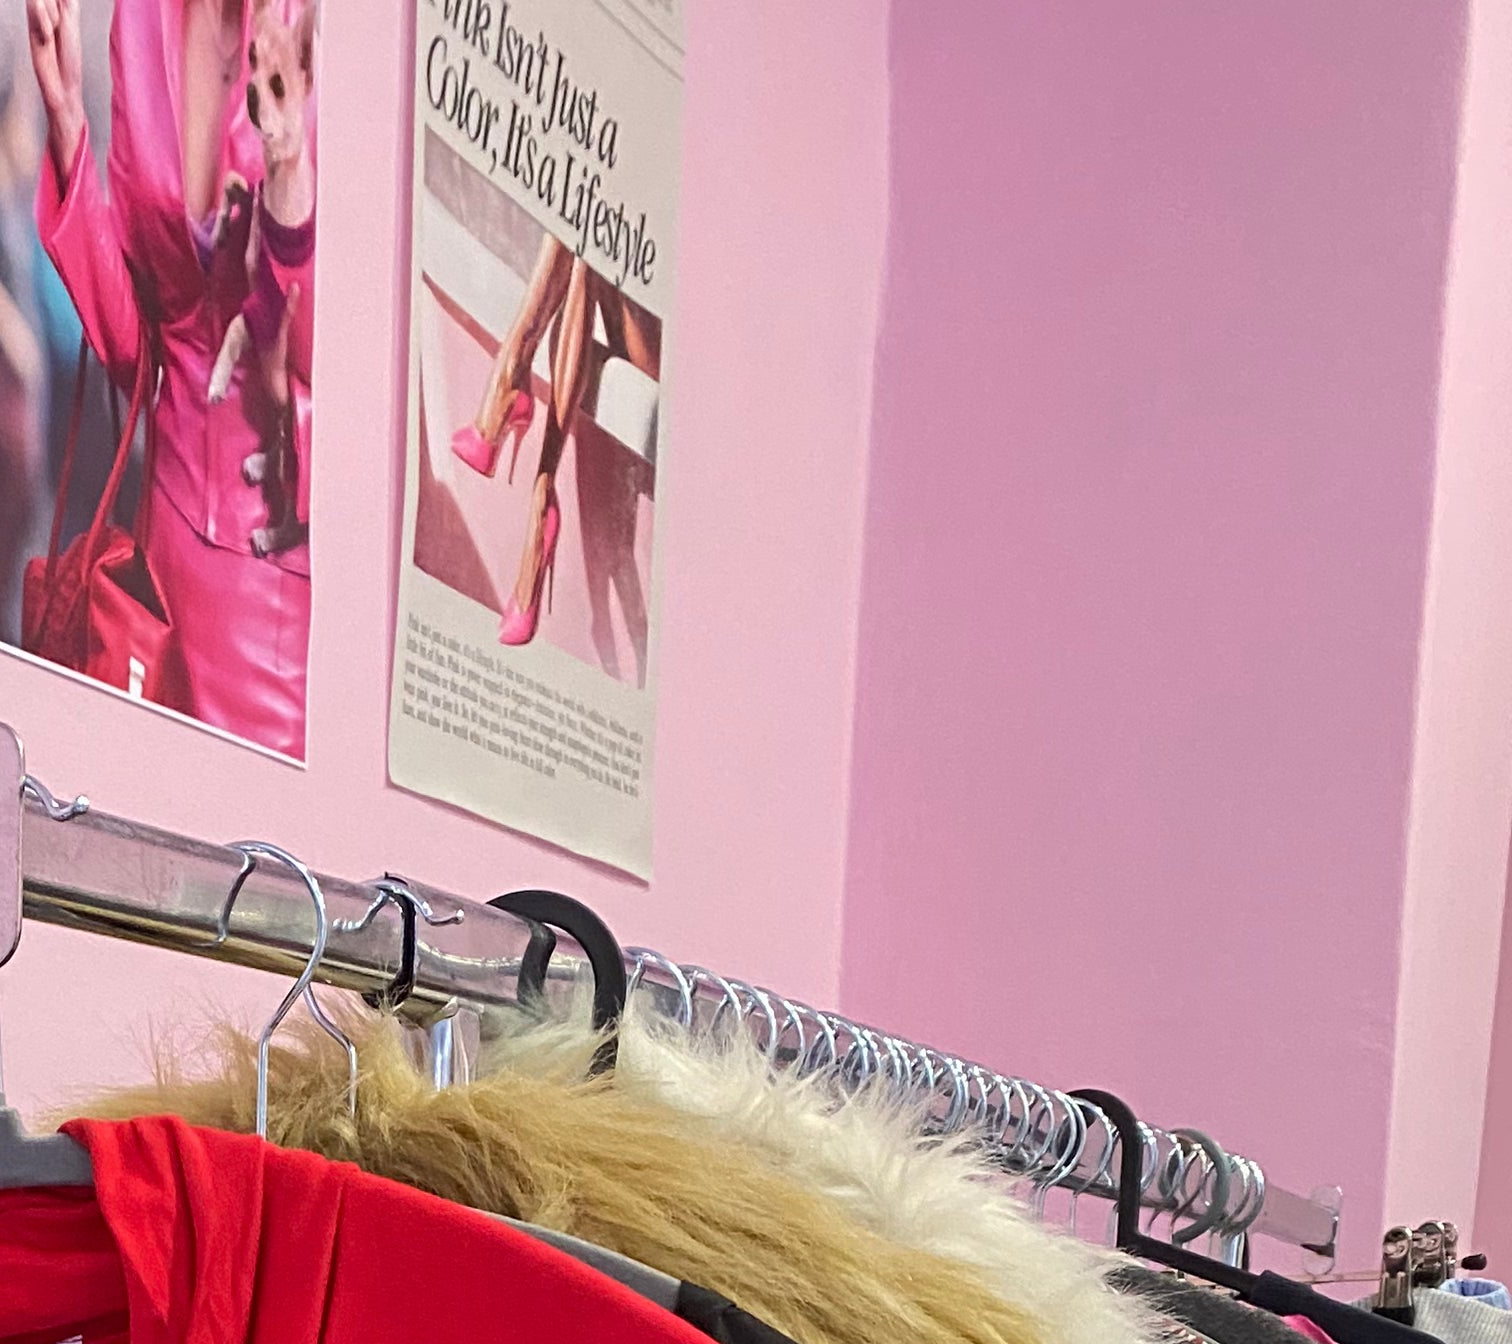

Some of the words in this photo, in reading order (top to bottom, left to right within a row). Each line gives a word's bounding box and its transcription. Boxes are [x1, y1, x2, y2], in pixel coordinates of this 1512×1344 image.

[426, 35, 499, 174] Color,
[501, 99, 537, 190] It's
[538, 154, 557, 208] a
[559, 151, 656, 287] Lifestyle
[492, 1, 549, 105] Isn't
[542, 51, 600, 150] Just
[598, 117, 618, 170] a
